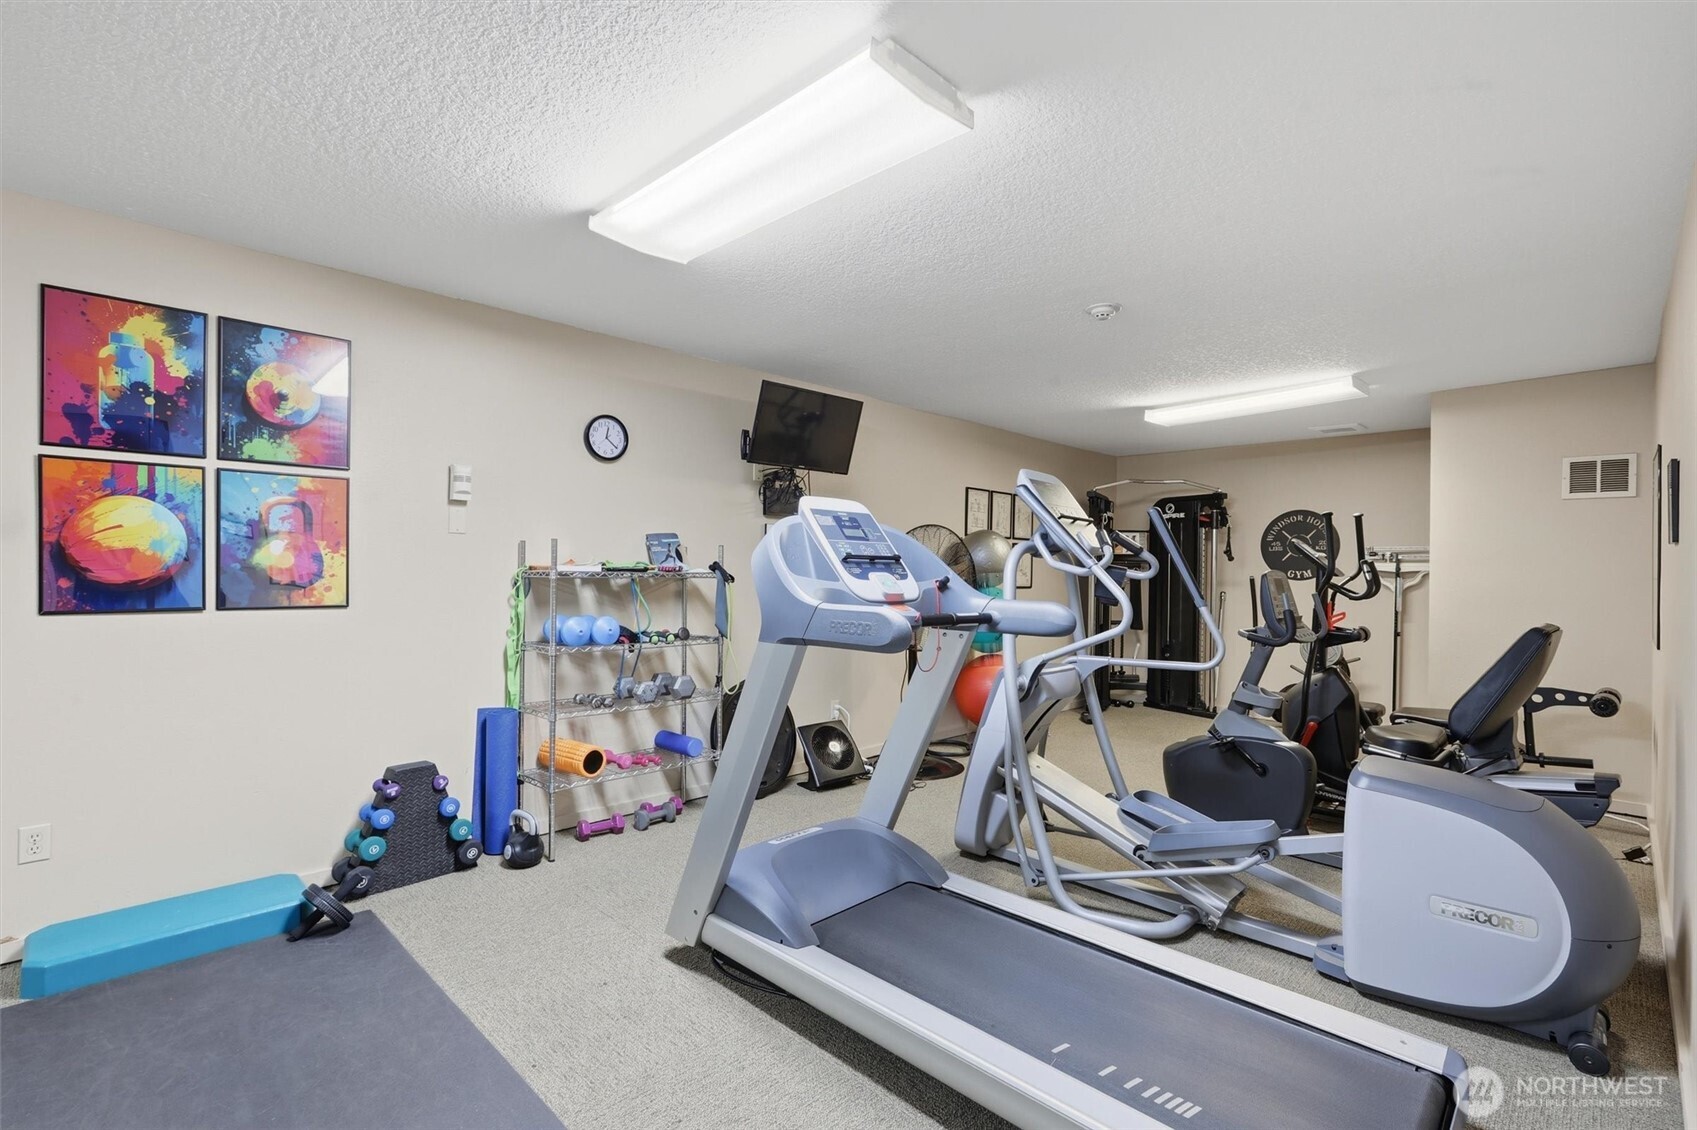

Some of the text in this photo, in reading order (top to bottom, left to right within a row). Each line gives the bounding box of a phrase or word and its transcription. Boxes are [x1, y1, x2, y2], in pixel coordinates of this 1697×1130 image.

[1266, 514, 1304, 541] WINDSOR
[1287, 569, 1313, 579] GYM
[829, 619, 872, 636] PRECOR
[1440, 901, 1514, 931] PRECOR
